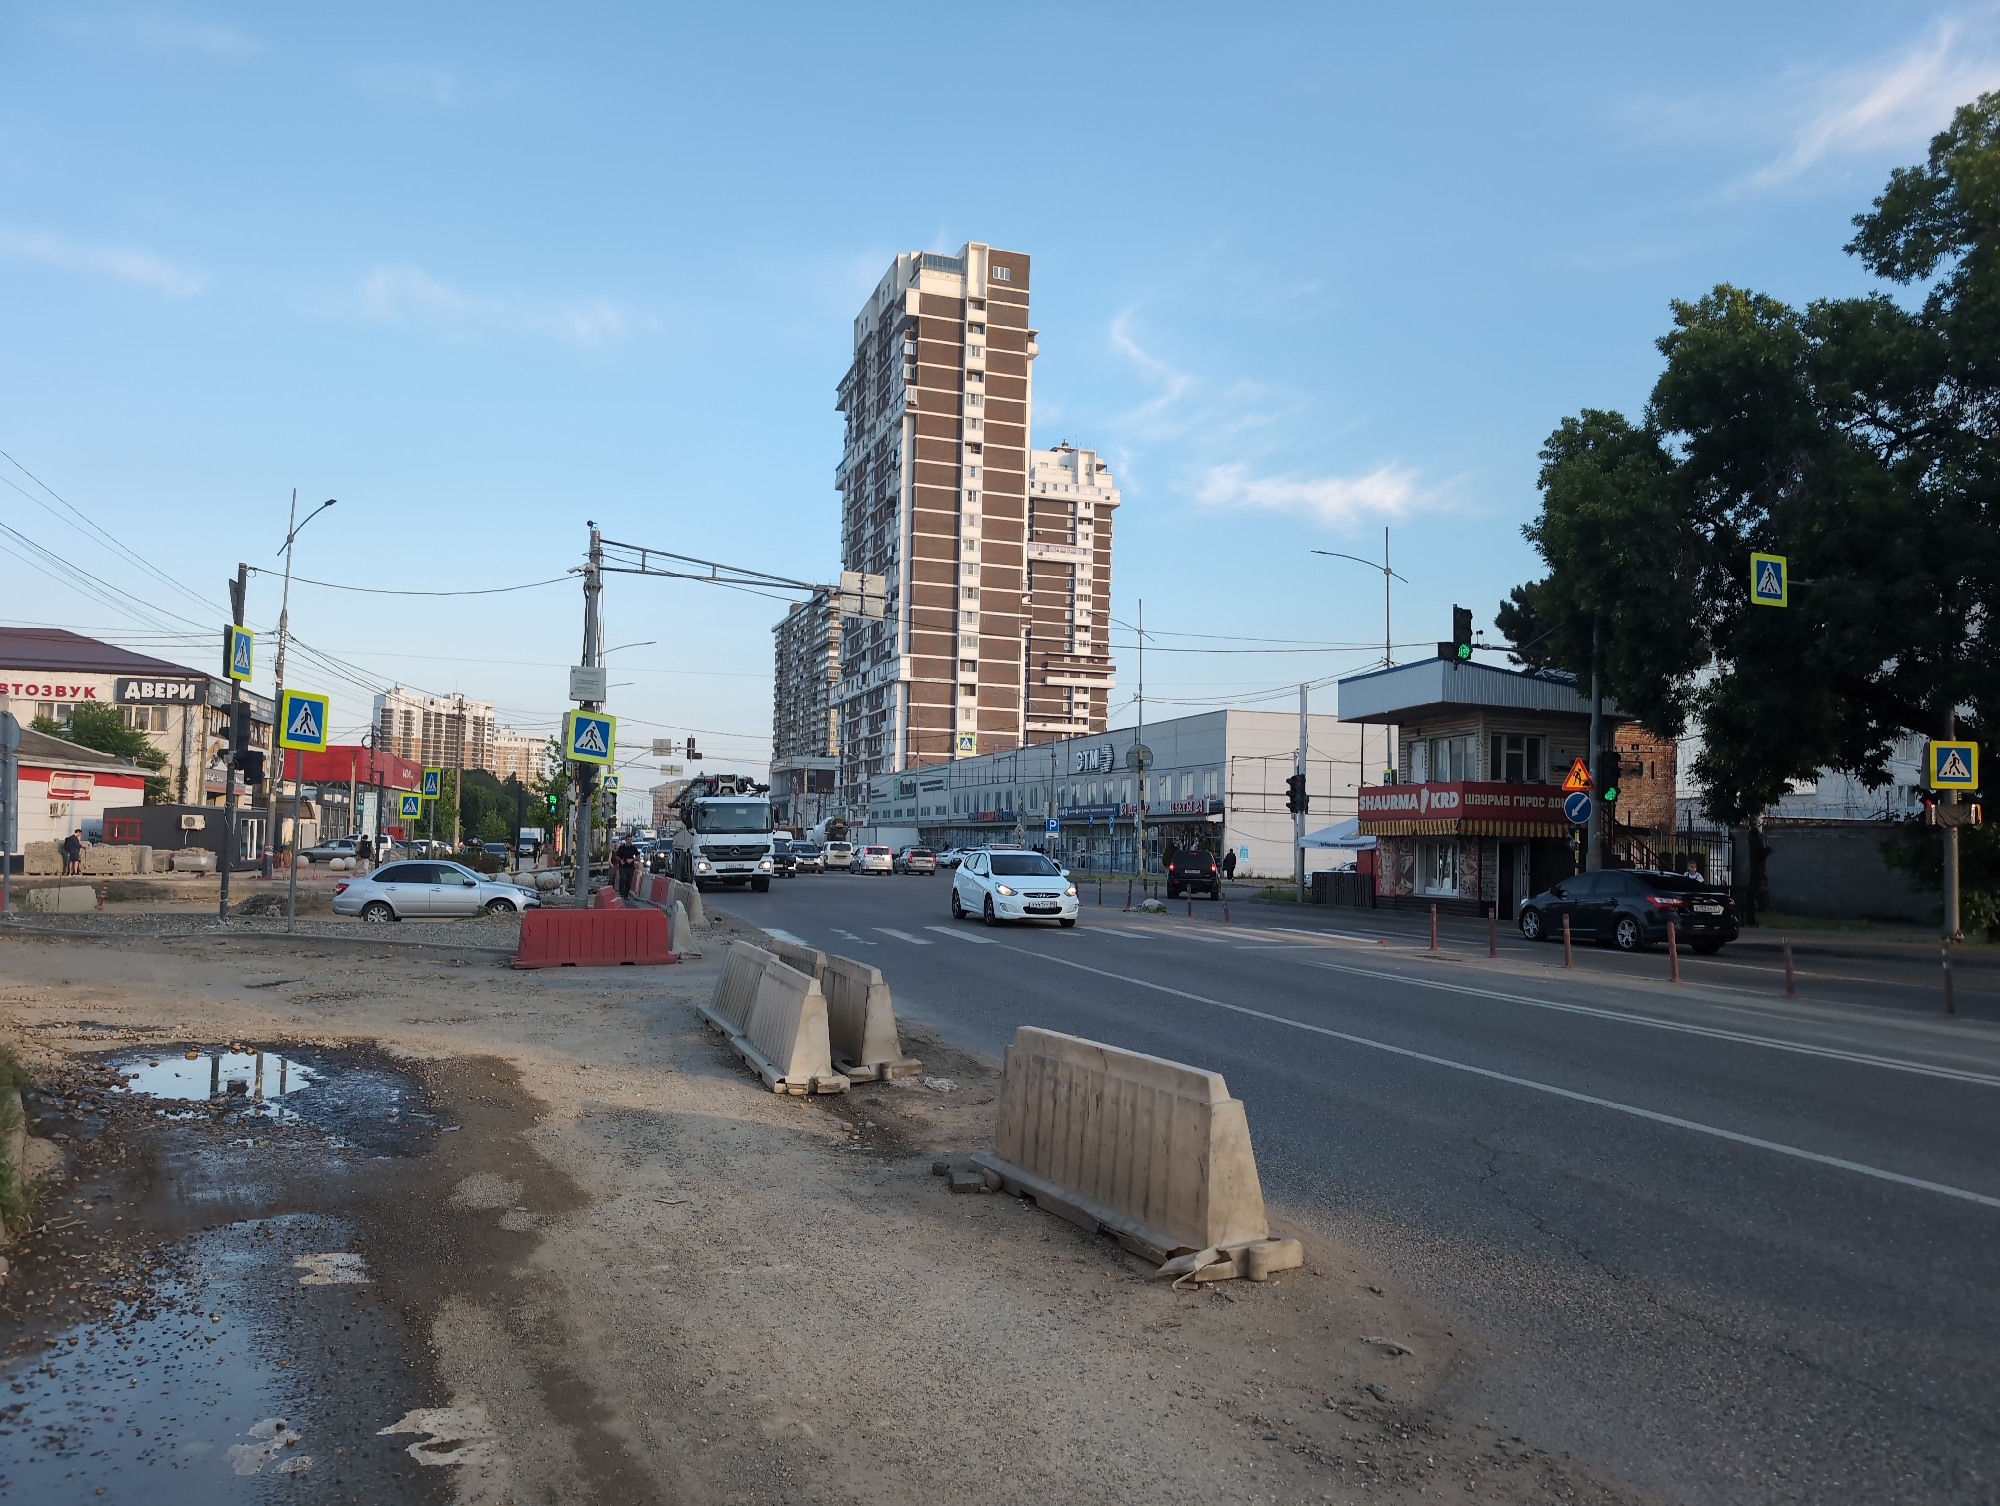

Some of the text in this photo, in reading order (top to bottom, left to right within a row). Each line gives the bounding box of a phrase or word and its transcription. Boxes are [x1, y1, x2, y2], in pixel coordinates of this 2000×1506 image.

[124, 681, 196, 700] ДВЕРИ
[1076, 748, 1100, 771] ЭТМ
[1170, 801, 1194, 814] ЦВЕТЫ
[1359, 791, 1459, 811] SHAURMA KRD
[1513, 795, 1545, 808] ГИРОС
